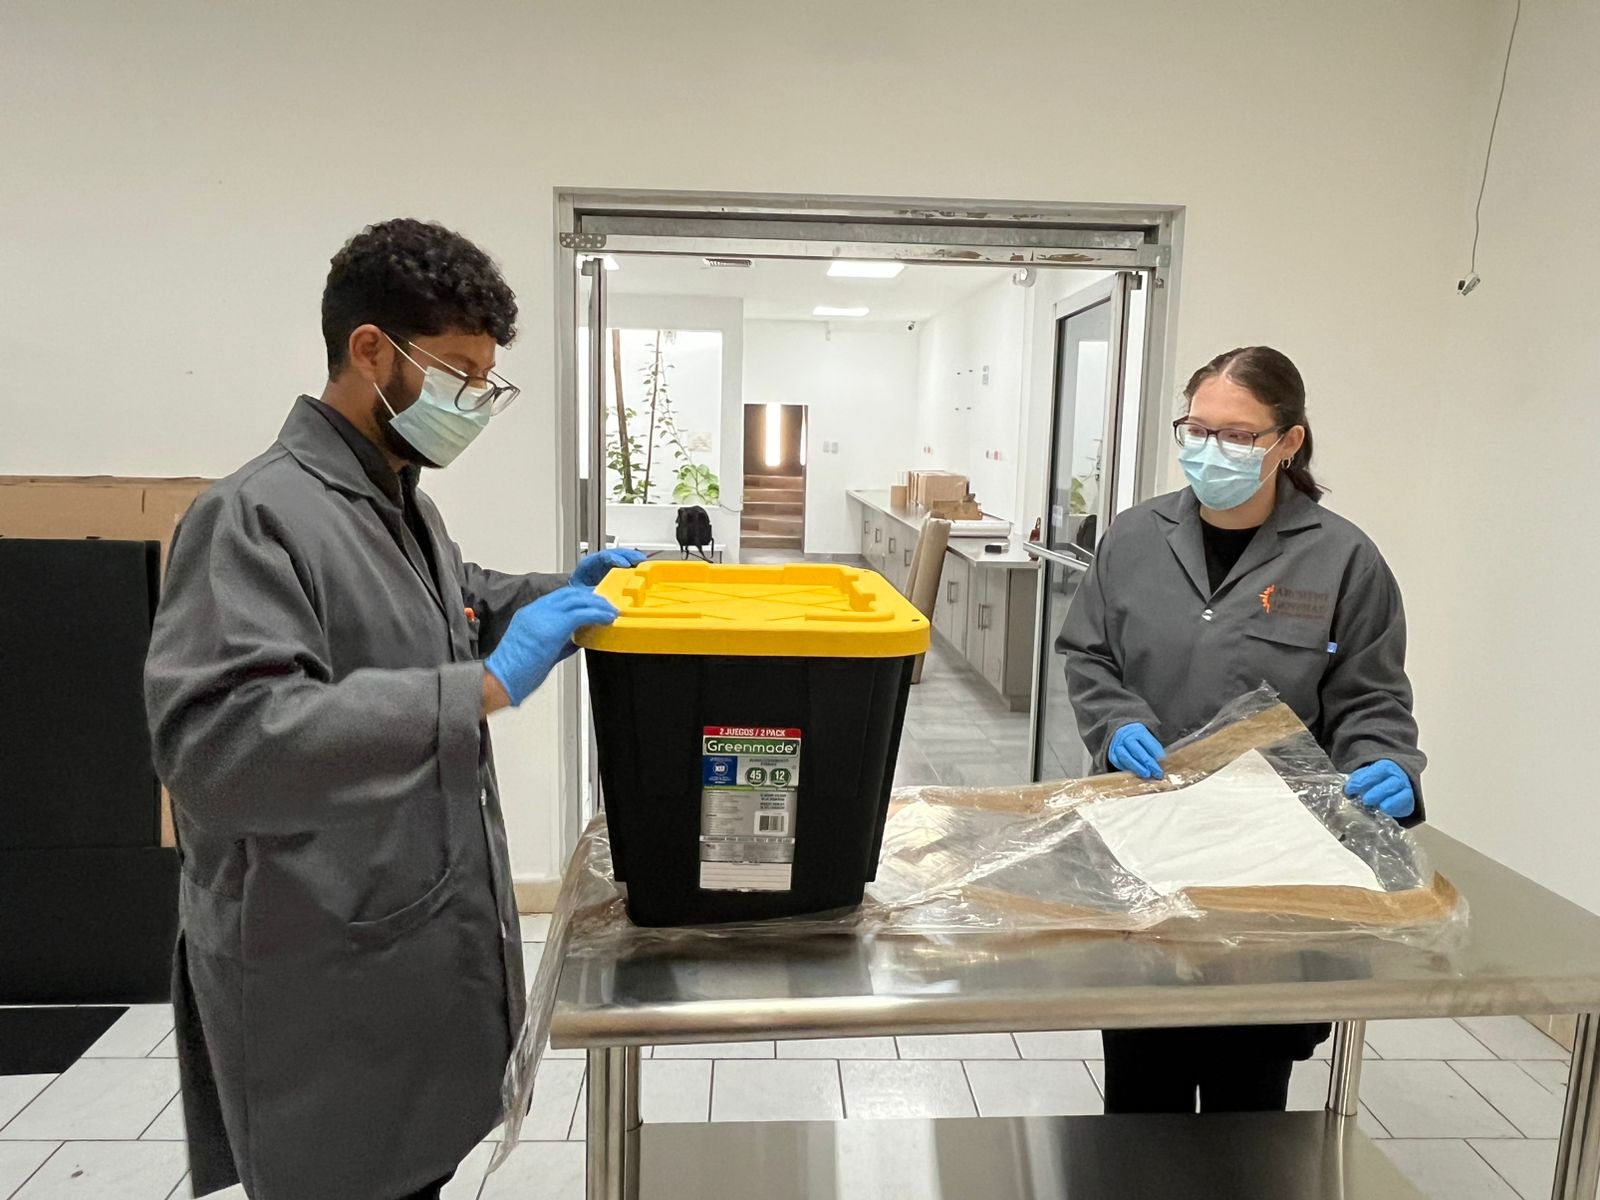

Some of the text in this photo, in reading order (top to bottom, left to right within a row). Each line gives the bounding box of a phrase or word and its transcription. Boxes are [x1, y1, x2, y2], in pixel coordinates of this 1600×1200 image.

[724, 728, 754, 736] JUEGOS
[766, 729, 786, 737] PACK
[707, 740, 794, 753] Greenmade
[749, 770, 762, 779] 45
[775, 770, 785, 781] 12
